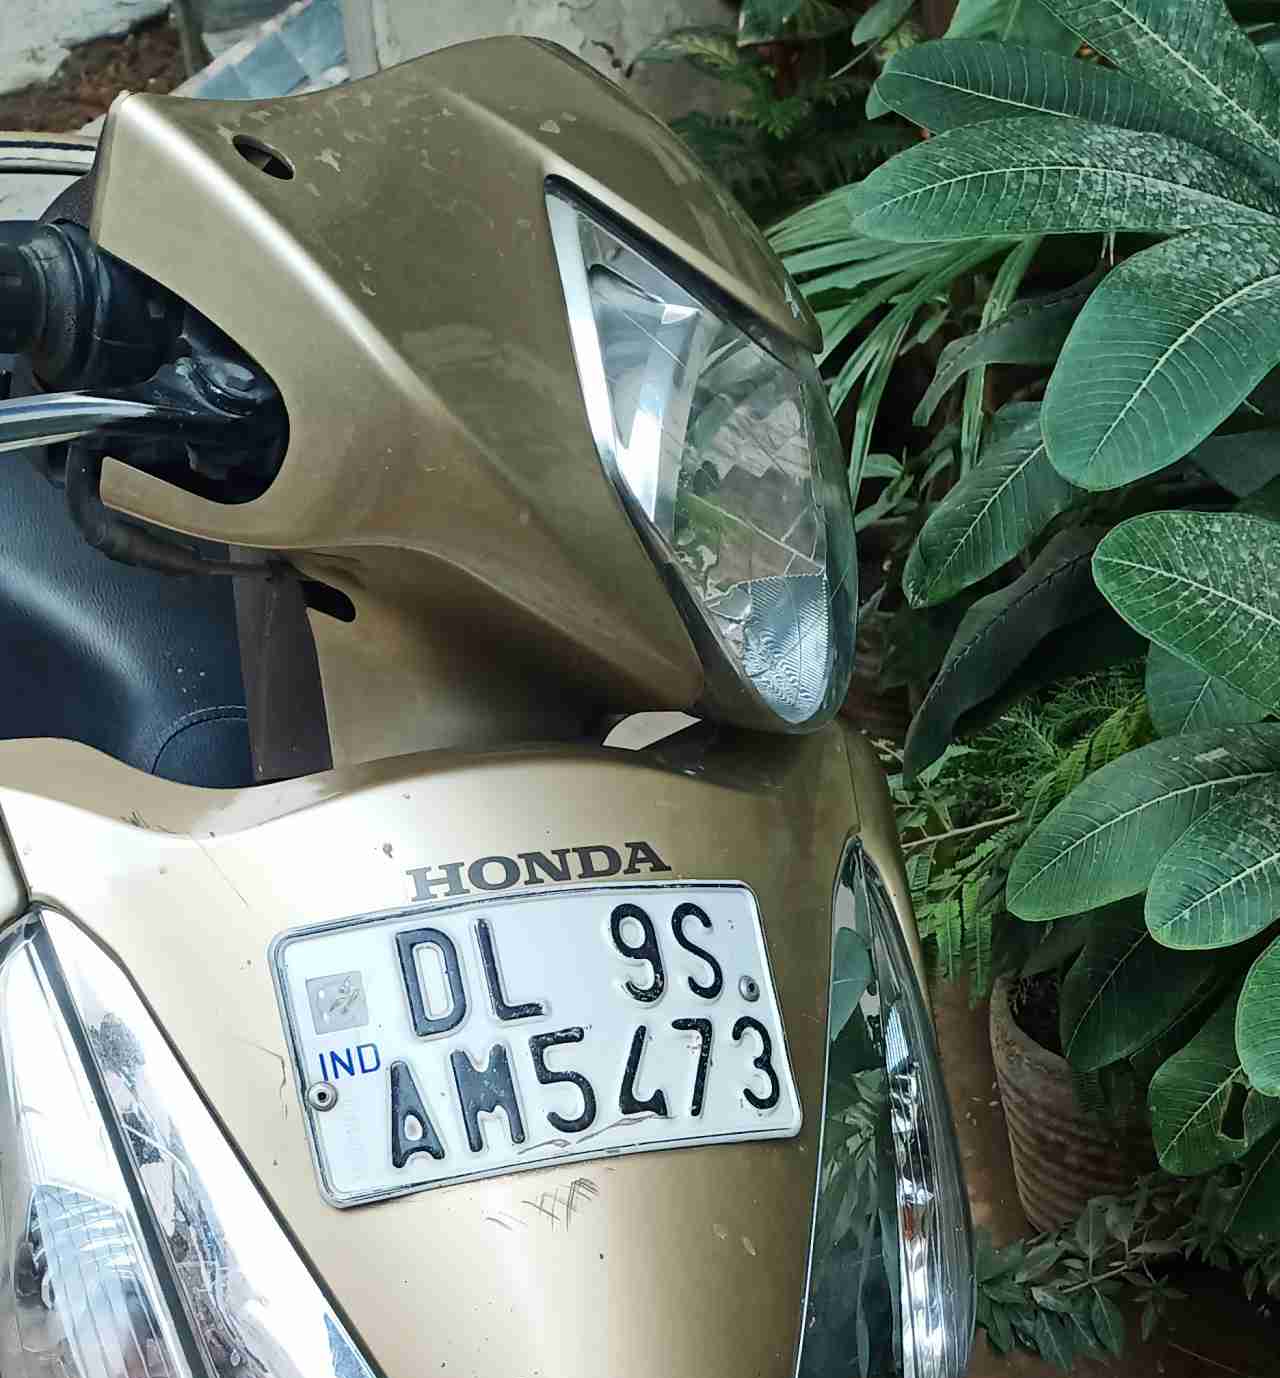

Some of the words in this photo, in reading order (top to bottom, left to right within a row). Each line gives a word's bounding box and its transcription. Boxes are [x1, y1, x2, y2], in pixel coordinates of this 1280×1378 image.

[406, 840, 671, 901] HONDA
[396, 919, 548, 1036] DL
[609, 903, 722, 1001] 9S
[318, 1043, 381, 1082] IND
[390, 1015, 782, 1168] AM5473
